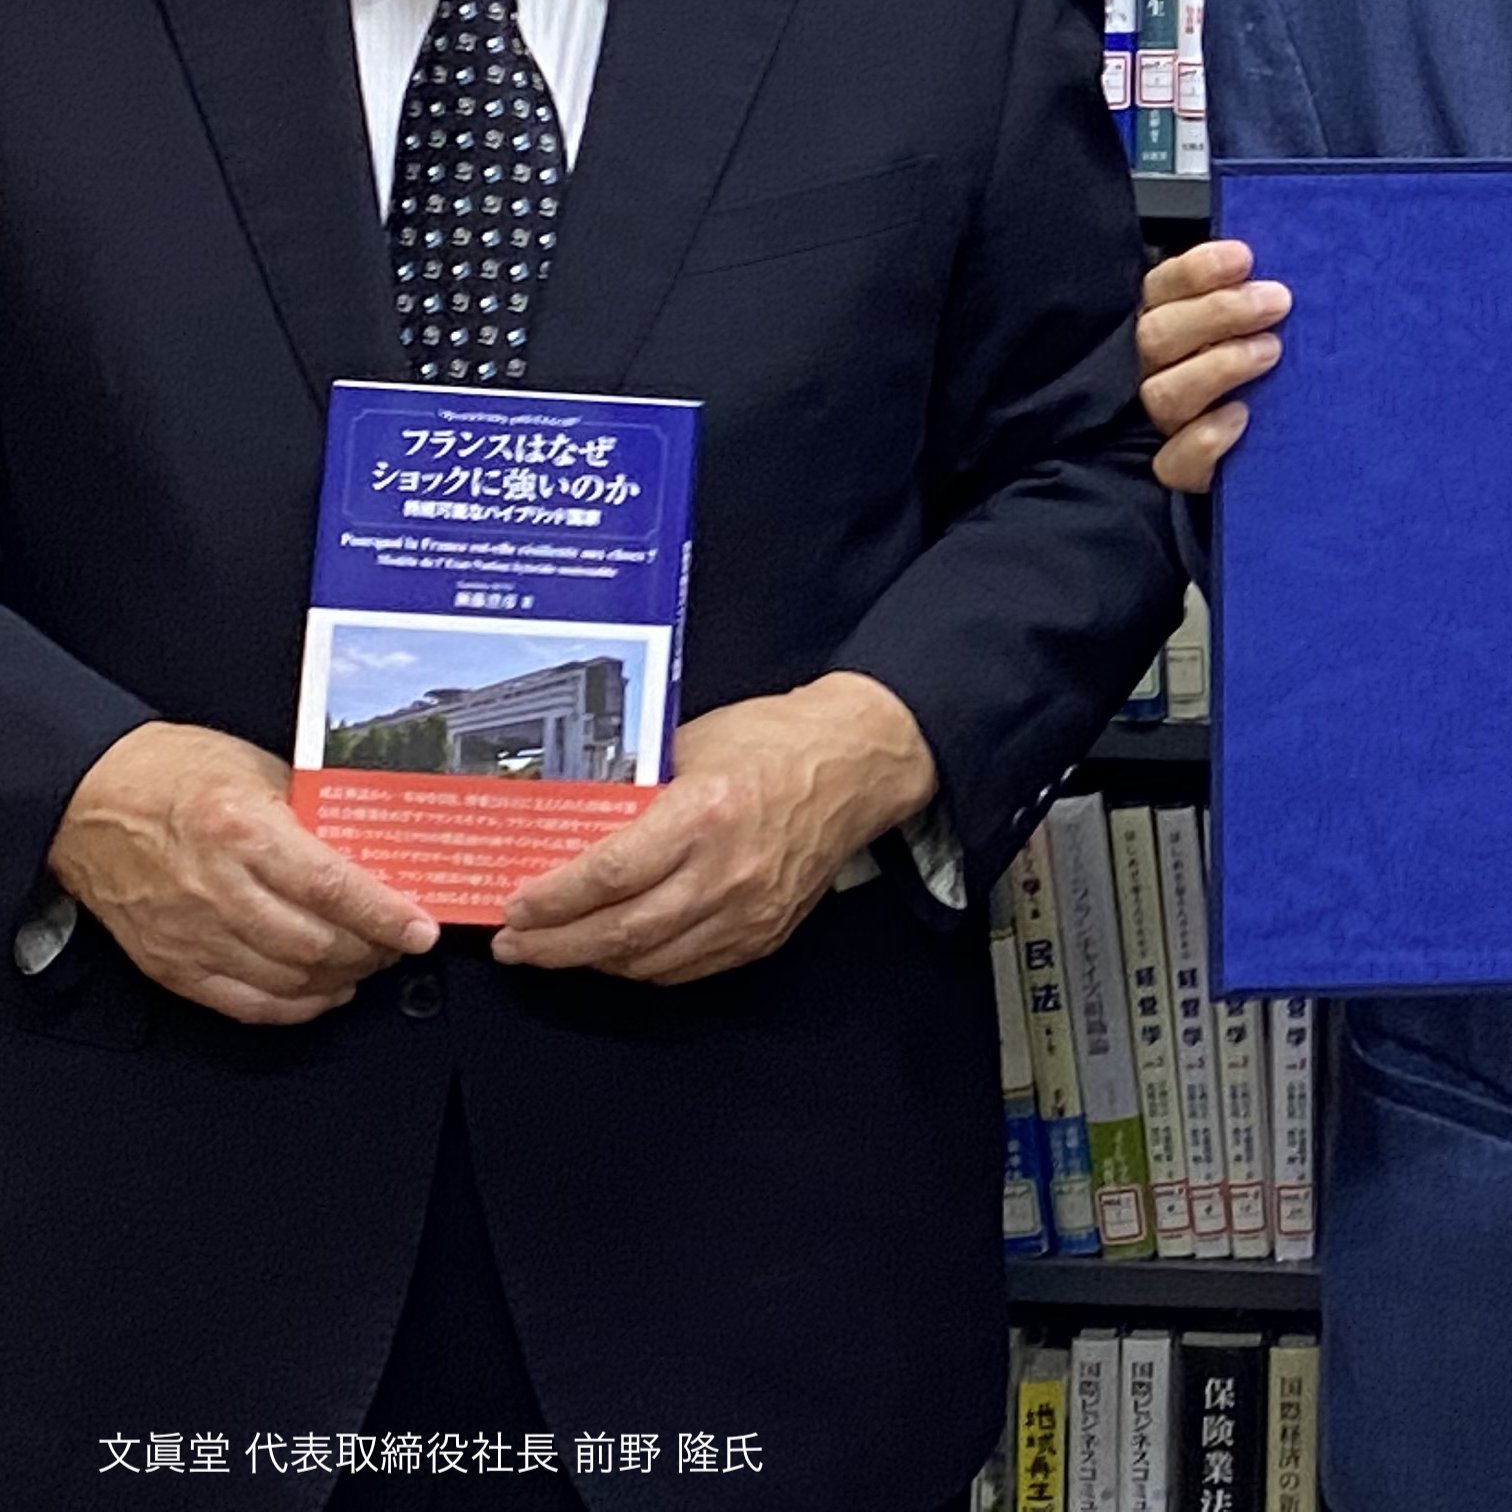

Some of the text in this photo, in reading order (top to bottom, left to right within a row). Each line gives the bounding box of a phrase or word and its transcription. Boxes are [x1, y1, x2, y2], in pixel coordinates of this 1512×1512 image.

[402, 425, 617, 468] フランスはなぜ
[371, 459, 642, 507] ショックに強いのか
[1023, 939, 1062, 1013] 民法
[1202, 1376, 1236, 1512] 保険業法
